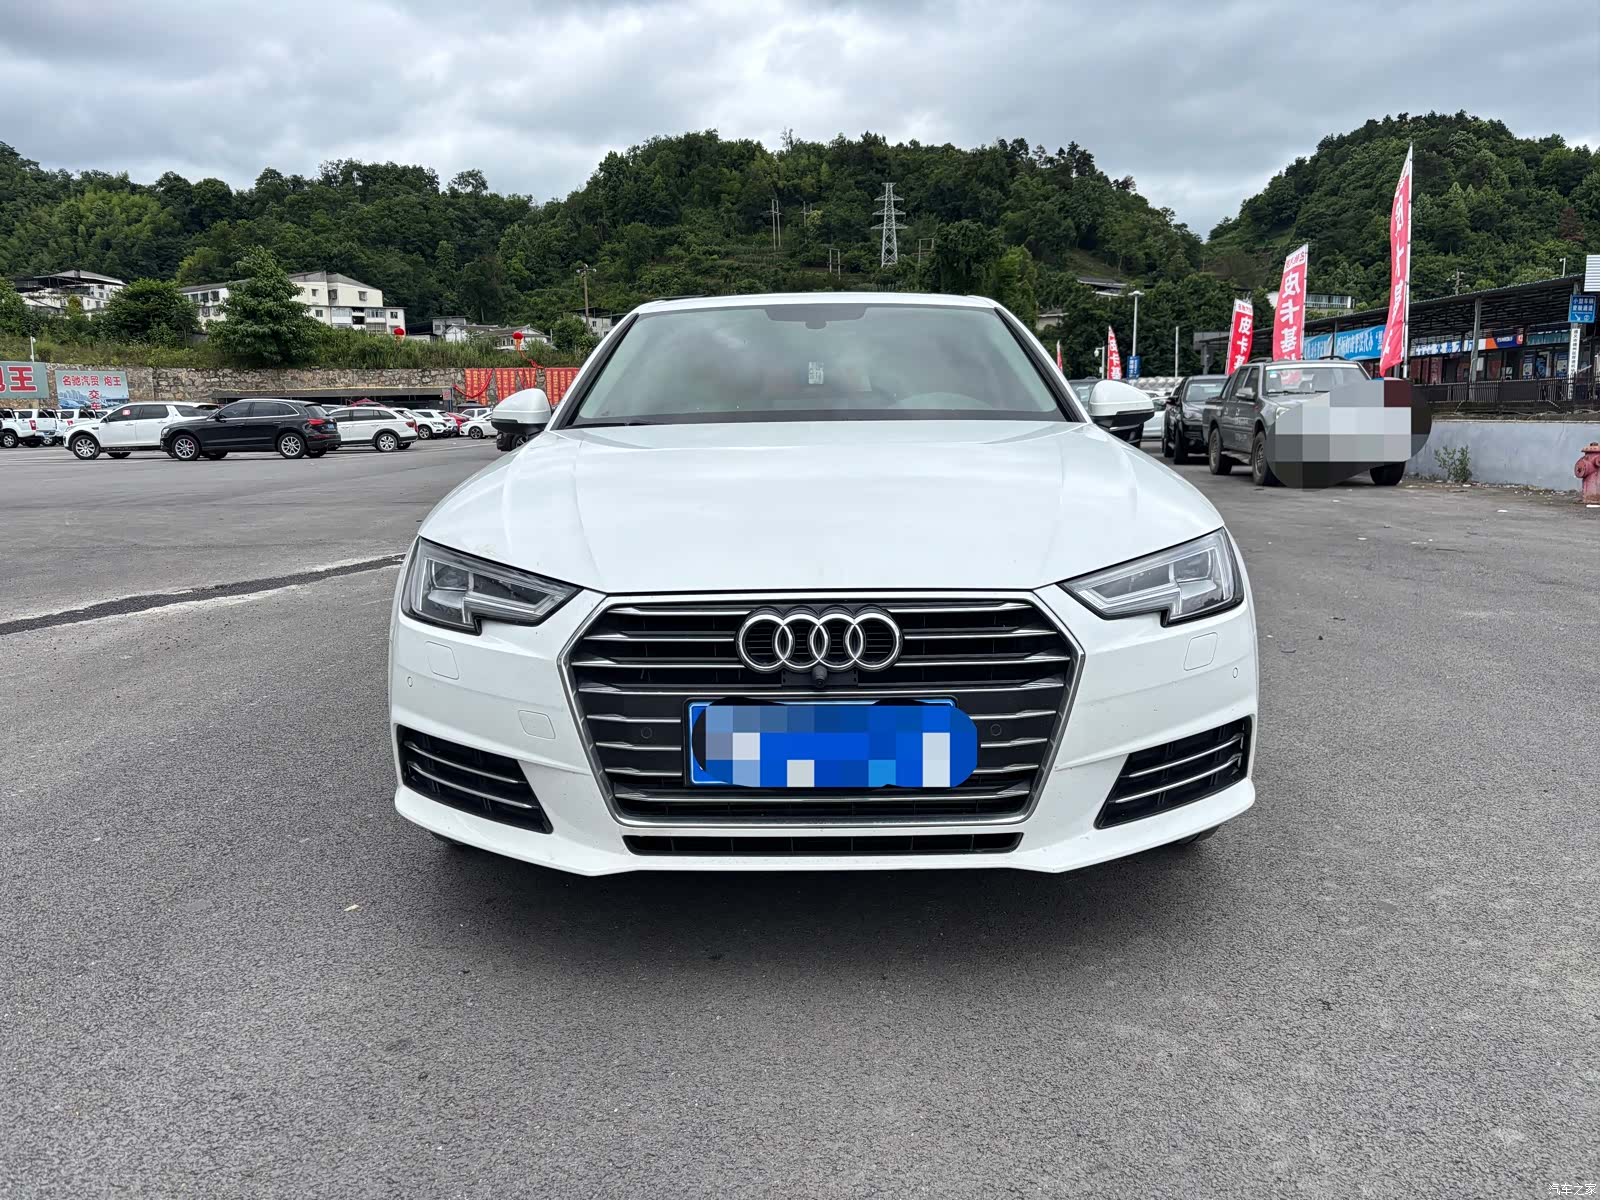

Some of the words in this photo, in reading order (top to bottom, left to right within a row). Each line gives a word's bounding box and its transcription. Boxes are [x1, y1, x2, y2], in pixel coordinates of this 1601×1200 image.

[62, 375, 100, 387] 名驰汽贸
[103, 376, 122, 387] 炮王
